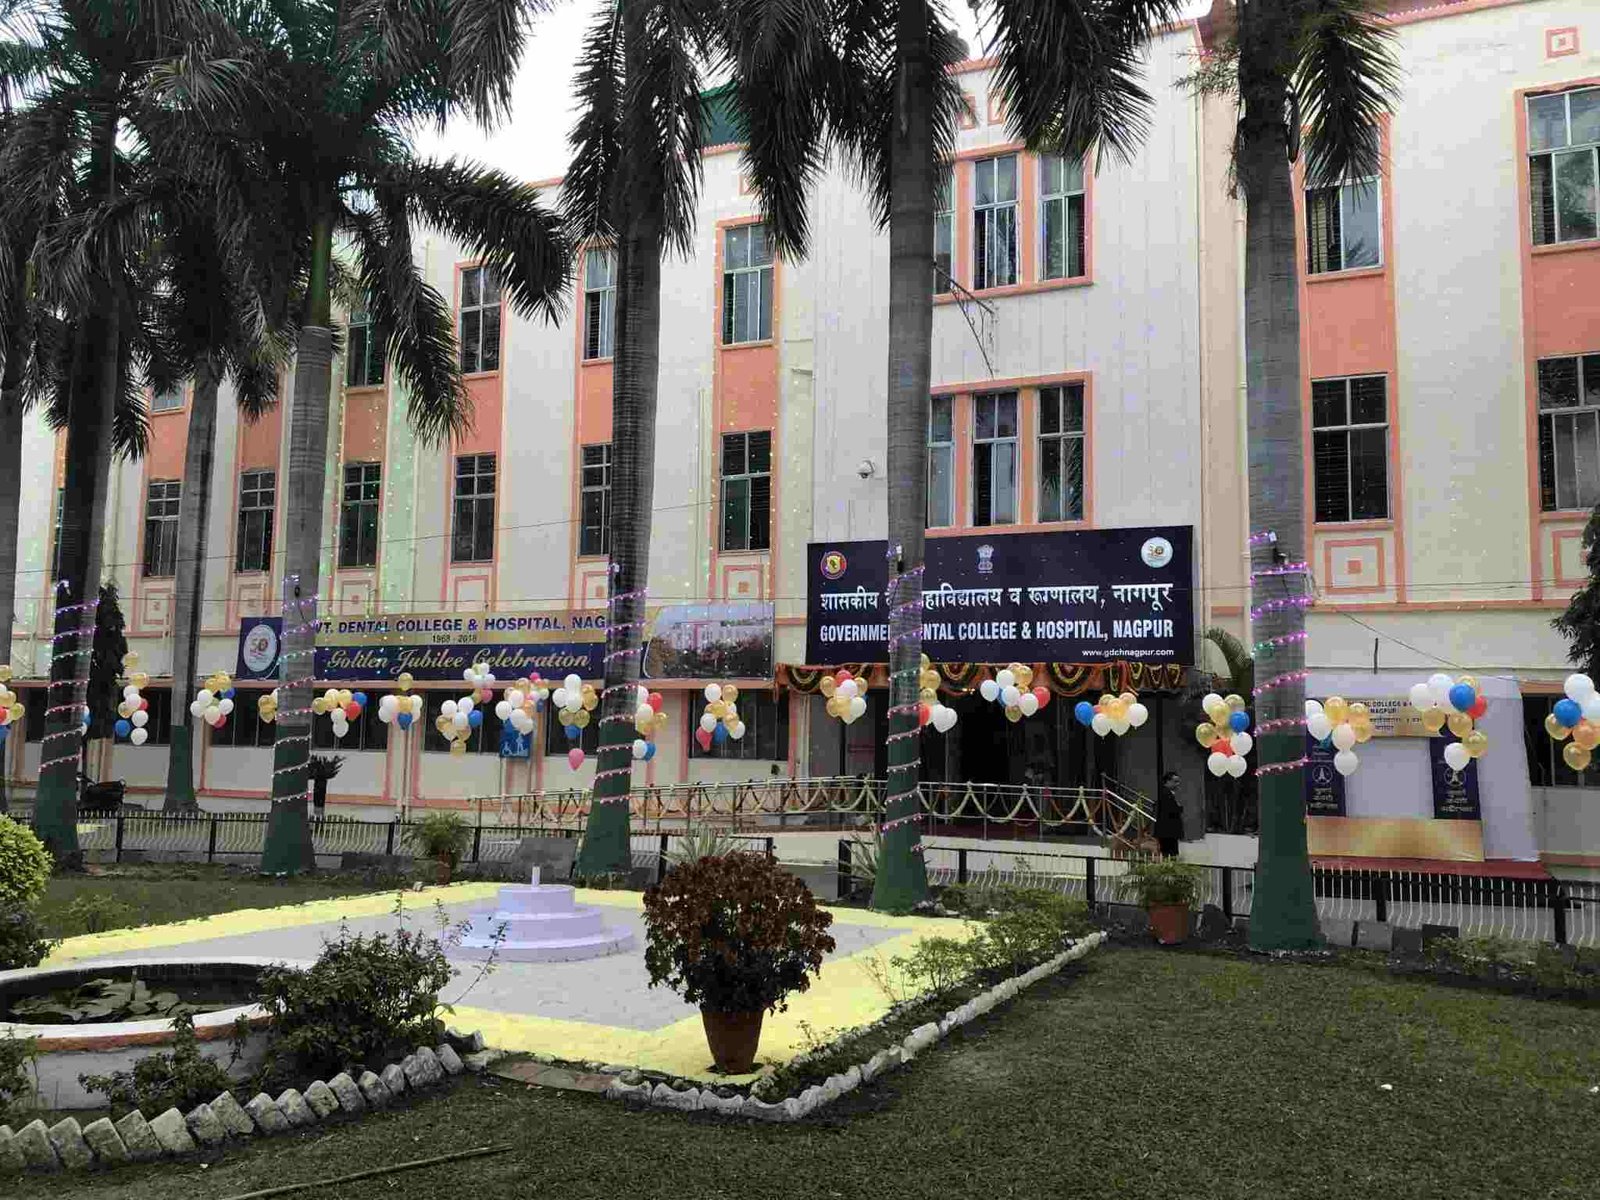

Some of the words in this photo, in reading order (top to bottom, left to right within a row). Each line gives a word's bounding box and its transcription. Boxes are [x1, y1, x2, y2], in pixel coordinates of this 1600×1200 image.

[820, 585, 879, 610] शासकीय
[1008, 587, 1022, 606] व
[1111, 583, 1174, 611] नागपूर
[338, 620, 391, 634] DENTAL
[396, 618, 463, 632] COLLEGE
[468, 618, 479, 631] &
[572, 615, 606, 629] NAG
[820, 624, 890, 642] GOVERNME
[921, 622, 954, 641] NTAL
[958, 621, 1017, 641] COLLEGE
[1021, 620, 1032, 640] &
[1036, 619, 1109, 642] HOSPITAL,
[1113, 619, 1174, 638] NAGPUR
[327, 650, 389, 669] Golden
[390, 648, 464, 675] Jubilee
[472, 647, 591, 669] Celebration
[1082, 648, 1174, 658] www.gdchnagpur.com
